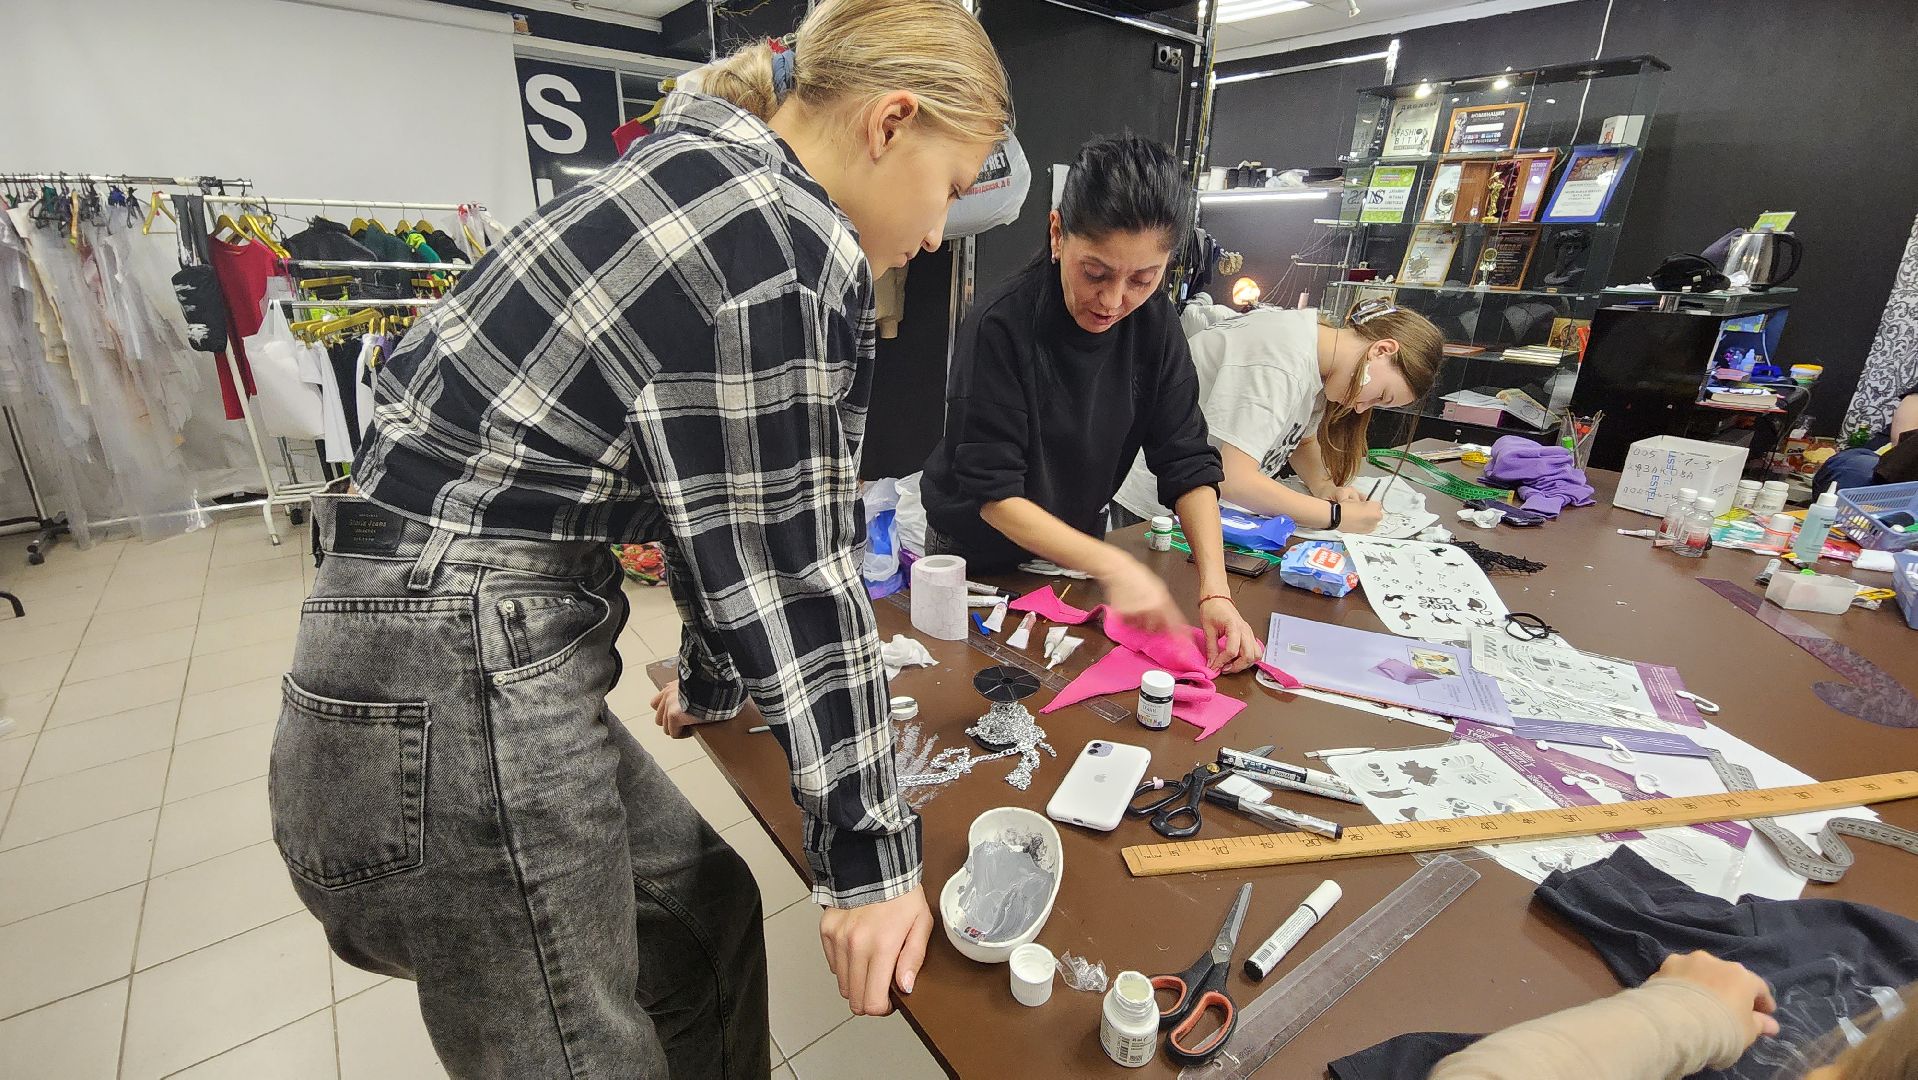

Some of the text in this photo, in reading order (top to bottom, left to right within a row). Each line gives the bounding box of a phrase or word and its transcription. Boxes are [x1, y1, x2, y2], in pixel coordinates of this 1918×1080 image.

[525, 73, 587, 154] S
[1647, 474, 1660, 502] ESTEL
[1211, 846, 1229, 856] 10
[1302, 838, 1321, 847] 20
[1391, 830, 1412, 838] 30
